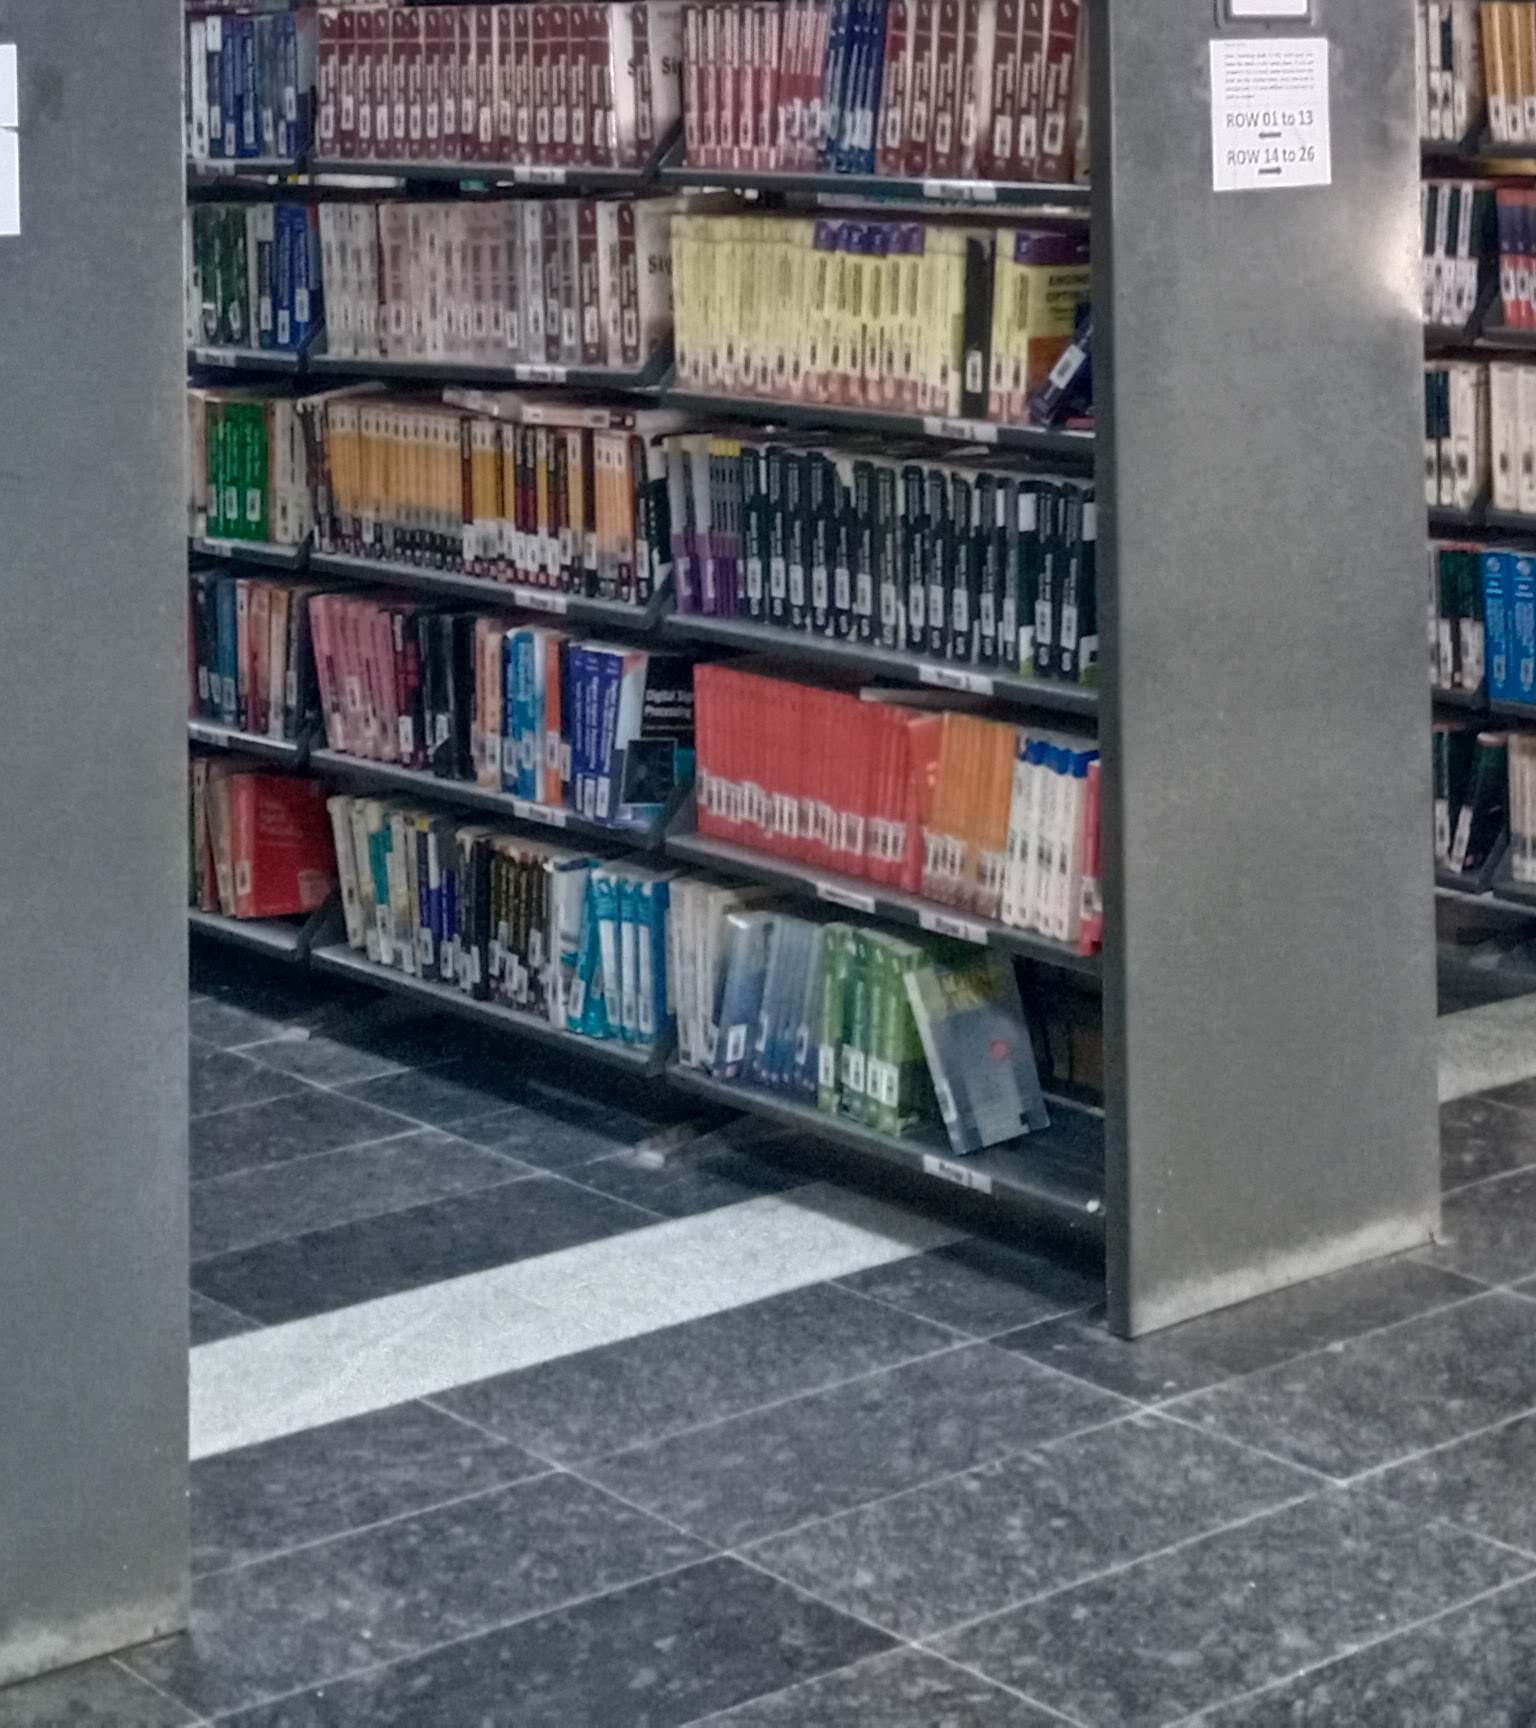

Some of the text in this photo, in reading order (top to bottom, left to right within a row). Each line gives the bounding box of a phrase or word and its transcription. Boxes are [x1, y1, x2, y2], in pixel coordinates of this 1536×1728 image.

[1225, 109, 1314, 130] ROW 01 to 13
[1226, 146, 1315, 167] ROW 14 to 26
